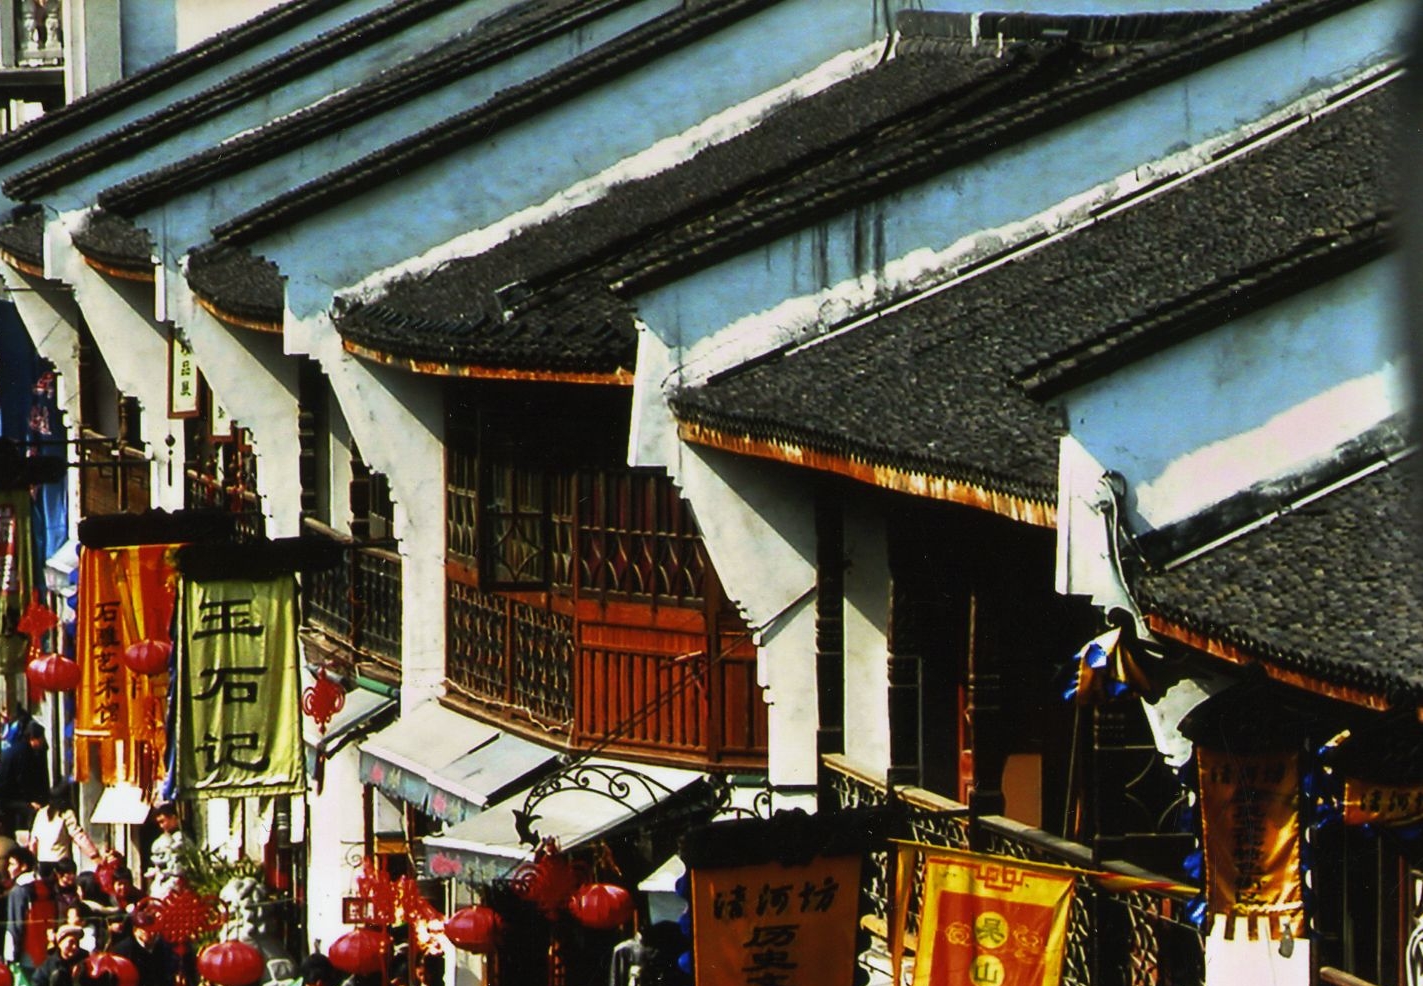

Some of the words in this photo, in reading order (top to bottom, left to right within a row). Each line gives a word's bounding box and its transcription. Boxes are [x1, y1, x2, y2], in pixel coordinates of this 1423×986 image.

[192, 599, 271, 773] 玉石记
[713, 876, 839, 920] 清河坊
